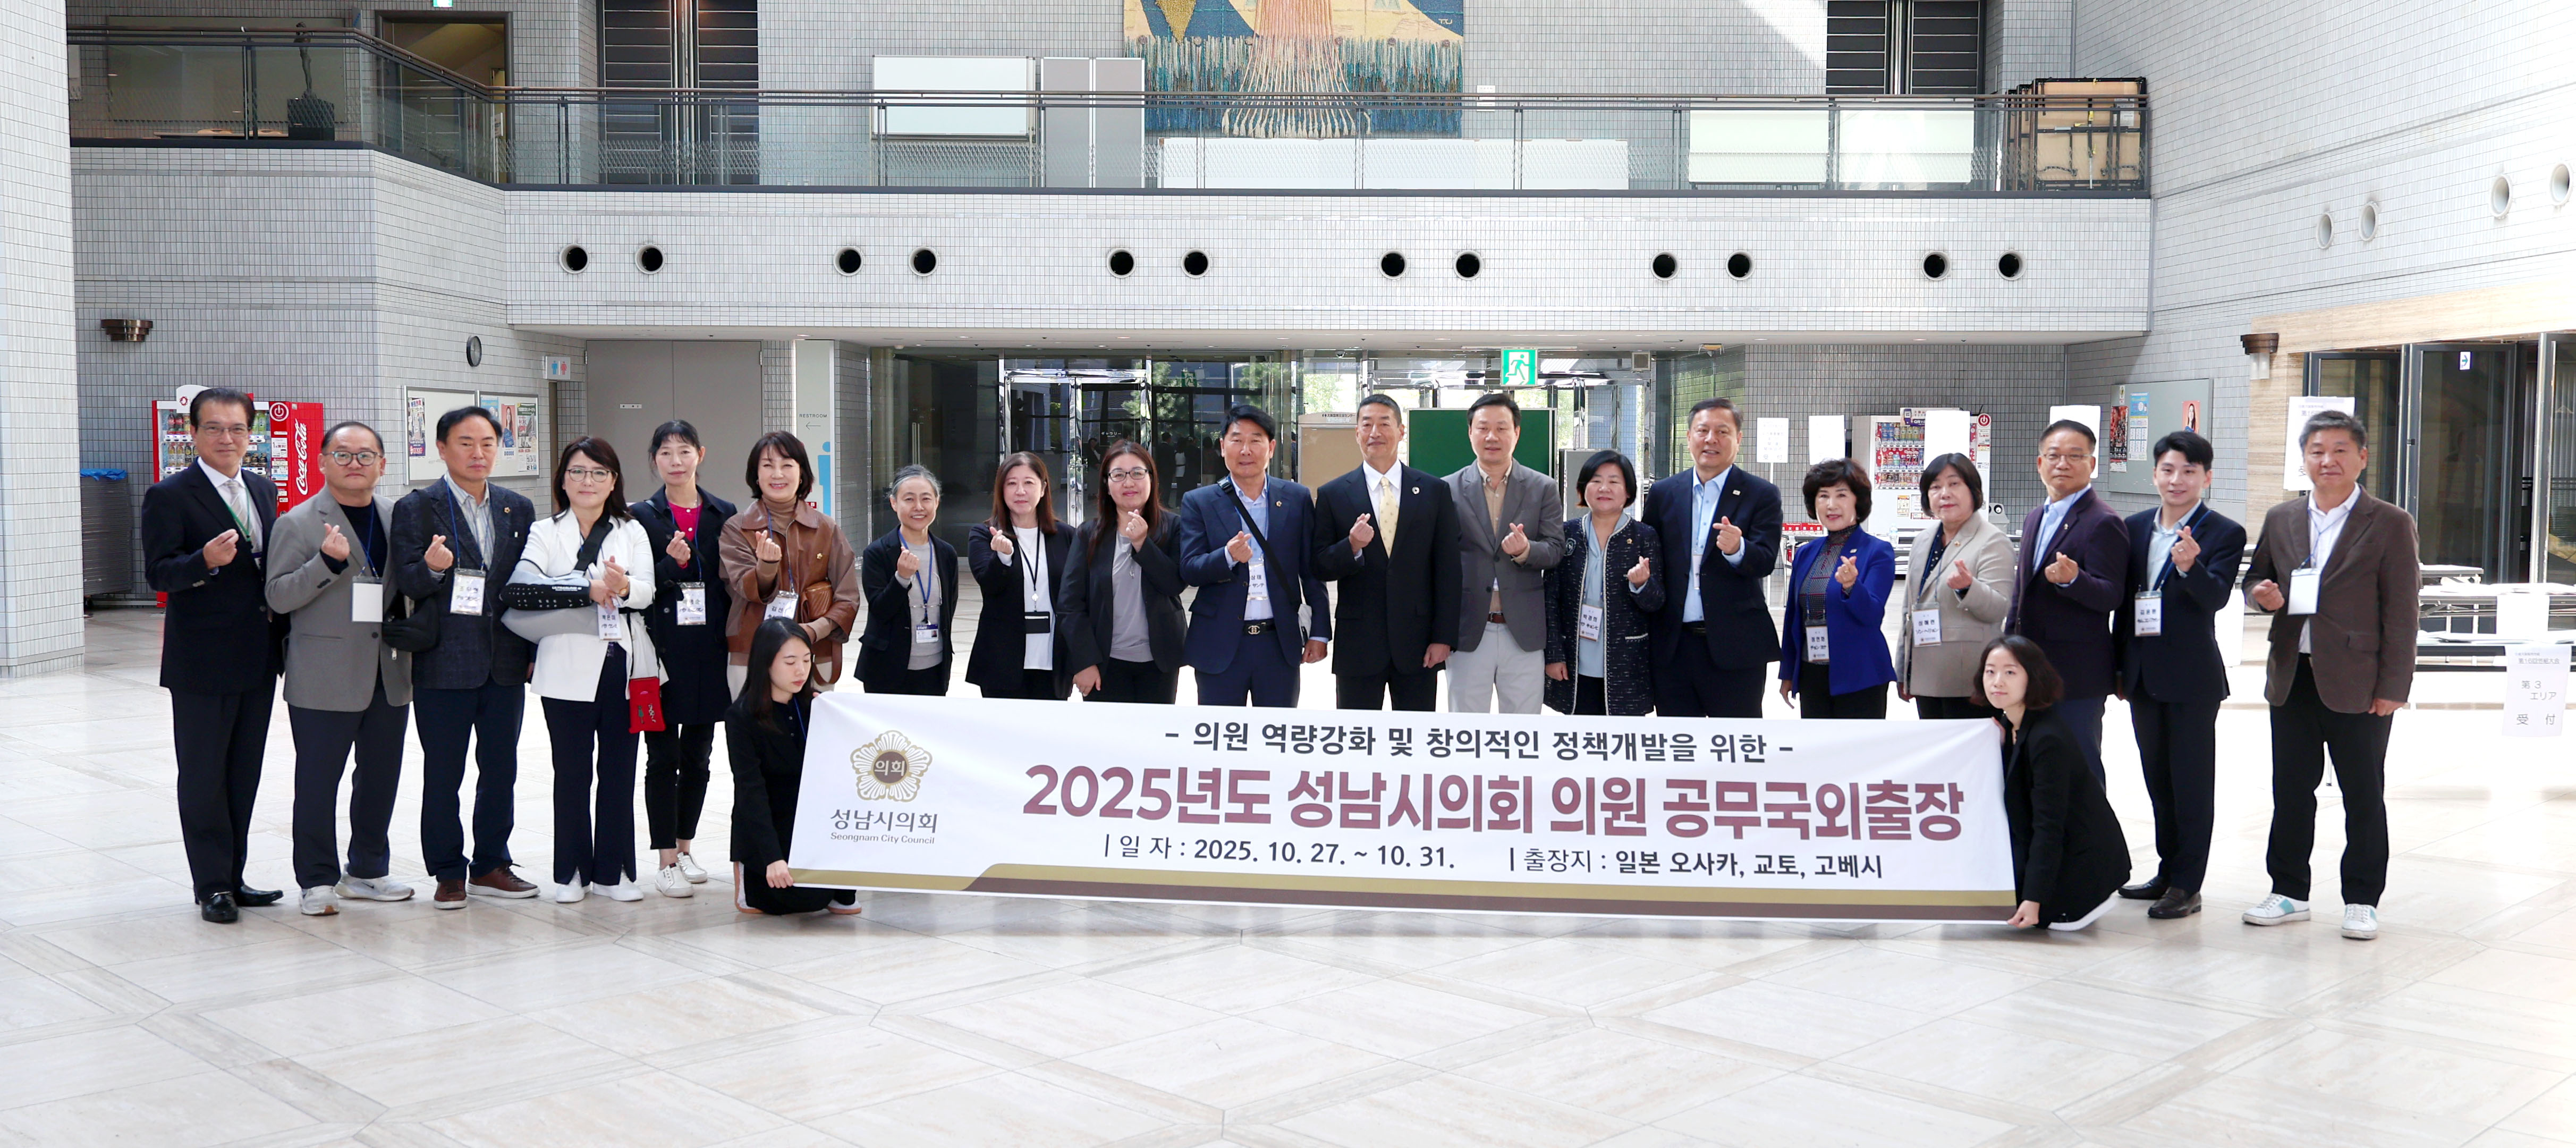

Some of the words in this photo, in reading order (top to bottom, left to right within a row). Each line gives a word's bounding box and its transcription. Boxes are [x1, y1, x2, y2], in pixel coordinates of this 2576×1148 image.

[2530, 691, 2557, 700] エリア
[1193, 722, 1248, 752] 의원
[1261, 724, 1376, 756] 역량강화
[1388, 728, 1413, 757] 및
[1426, 728, 1539, 759] 창의적인
[1552, 731, 1697, 762] 정책개발을
[1710, 734, 1767, 763] 위한
[874, 759, 906, 777] 의회
[1023, 764, 1272, 825] 2025년도
[1287, 770, 1533, 834] 성남시의회
[1550, 777, 1647, 837] 의원
[1663, 779, 1964, 841] 공무국외출장
[830, 808, 938, 833] 성남시의회
[830, 832, 879, 843] Seongnam
[880, 835, 899, 845] City
[901, 835, 936, 845] Council
[1194, 839, 1258, 862] 2025.
[1268, 841, 1301, 864] 10.
[1311, 843, 1345, 865] 27.
[1378, 845, 1411, 867] 10.
[1420, 846, 1454, 869] 31.
[1523, 848, 1591, 873] 출장지
[1616, 850, 1660, 874] 일본
[1670, 852, 1744, 878] 오사카,
[1753, 855, 1806, 879] 교토,
[1815, 855, 1882, 879] 고베시
